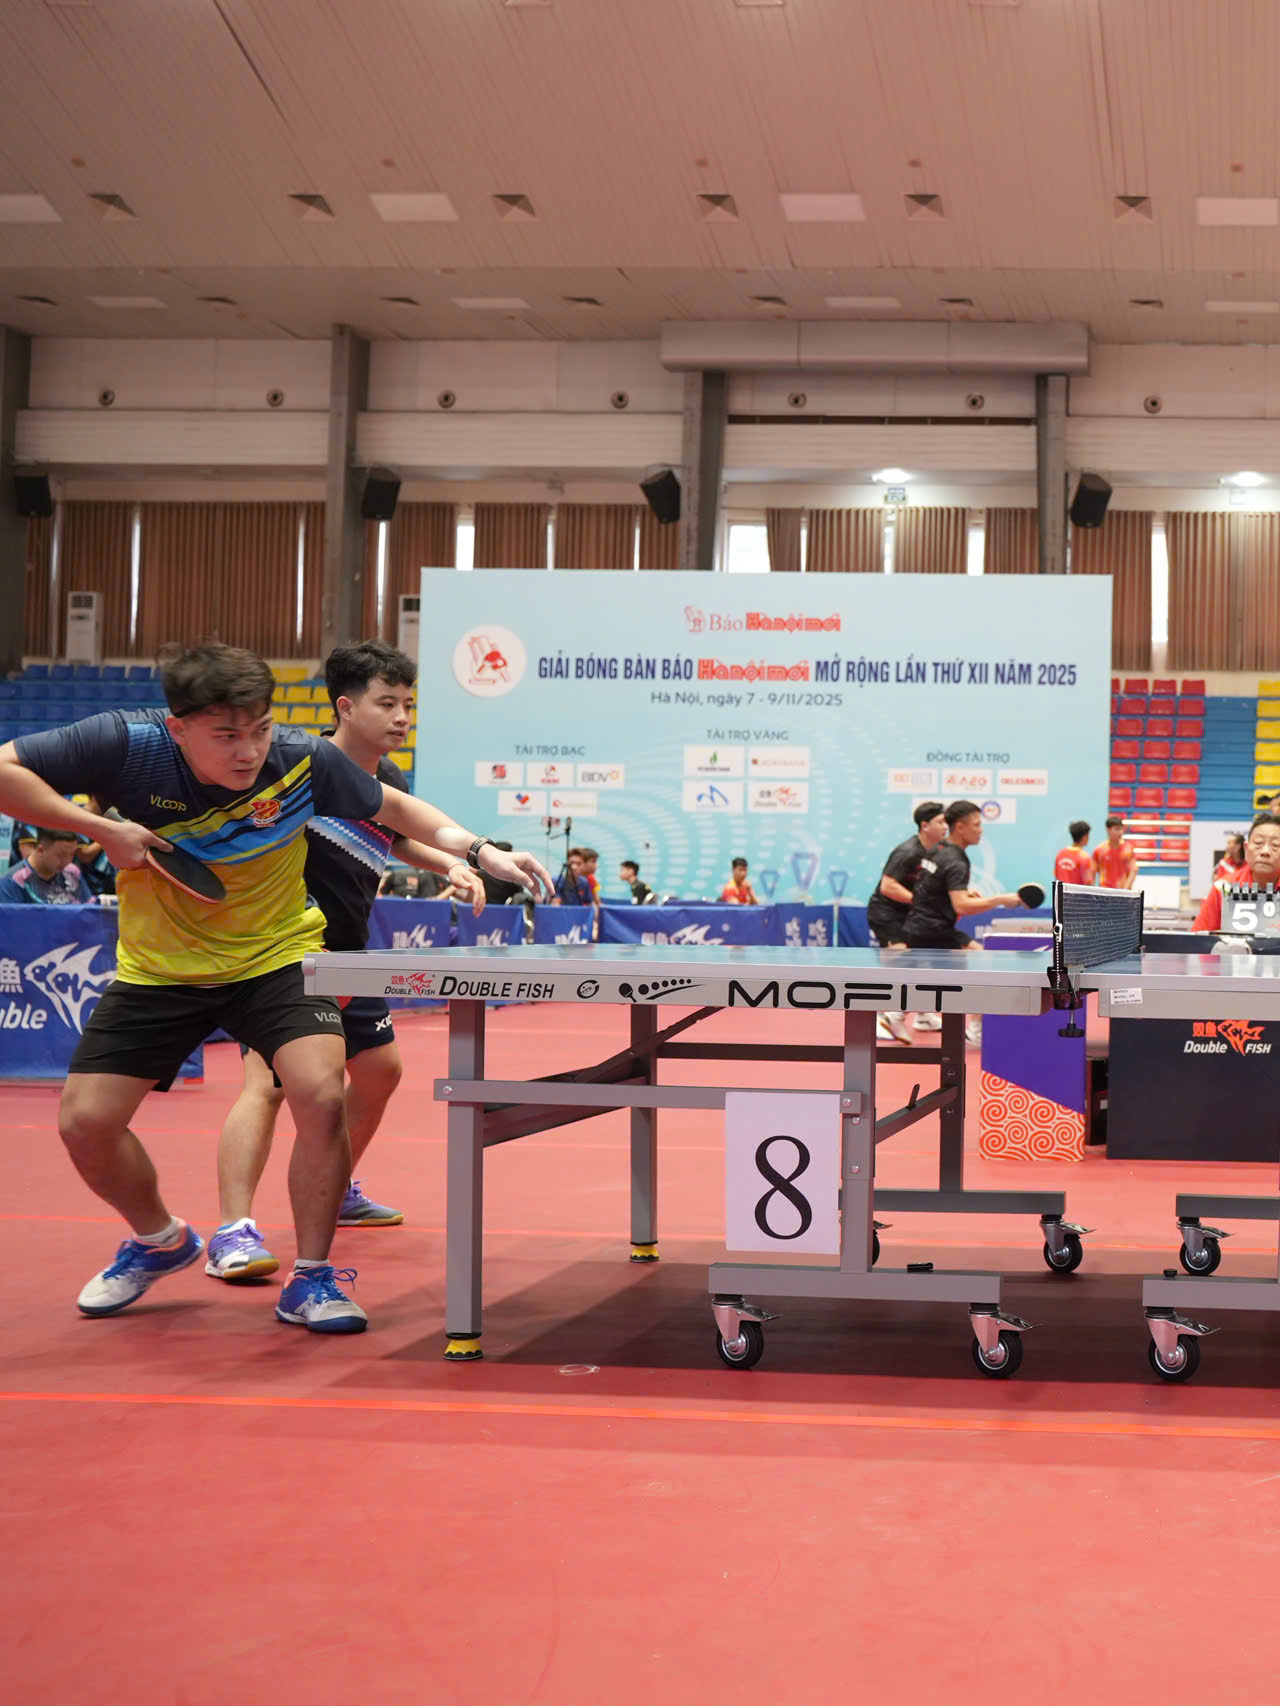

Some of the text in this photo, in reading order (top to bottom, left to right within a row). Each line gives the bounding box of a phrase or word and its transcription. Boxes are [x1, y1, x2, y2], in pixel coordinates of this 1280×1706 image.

[709, 614, 743, 632] Báo
[538, 650, 569, 679] GIẢI
[575, 652, 618, 680] BÓNG
[623, 652, 656, 680] BÀN
[661, 653, 693, 680] BÁO
[815, 653, 841, 683] MỞ
[845, 656, 890, 688] RỘNG
[932, 657, 964, 684] THỨ
[967, 661, 989, 684] XII
[994, 658, 1032, 685] NĂM
[1037, 663, 1077, 686] 2025
[651, 691, 671, 704] Hà
[707, 692, 742, 707] ngày
[746, 692, 755, 705] 7
[767, 692, 843, 706] 9/11/2025
[1232, 903, 1258, 931] 5
[1263, 902, 1276, 917] 0
[516, 982, 555, 999] FISH
[728, 979, 963, 1013] MOFIT
[1183, 1040, 1272, 1054] Double FISH
[754, 1135, 813, 1240] 8
